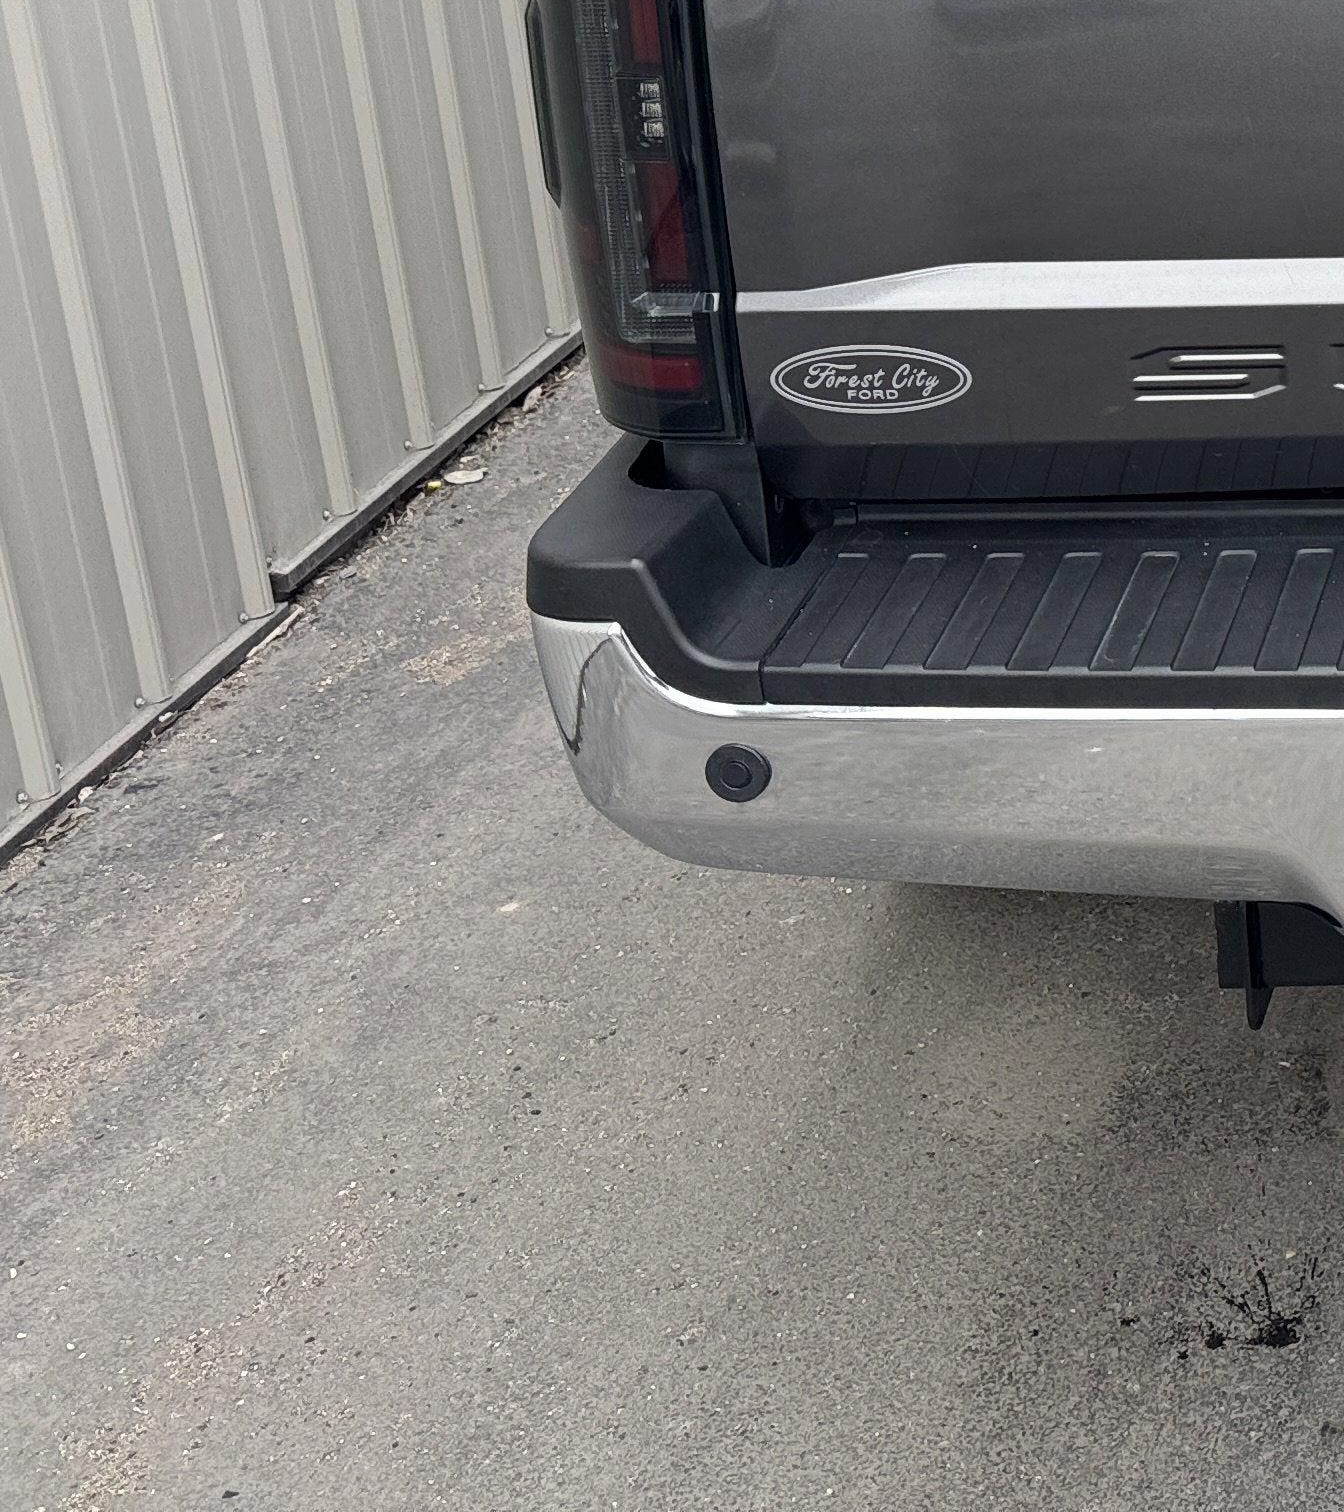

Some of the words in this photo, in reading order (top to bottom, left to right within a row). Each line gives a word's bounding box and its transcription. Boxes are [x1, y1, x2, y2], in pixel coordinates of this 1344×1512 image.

[803, 362, 886, 389] Forest
[892, 363, 940, 397] City
[847, 389, 899, 400] FORD
